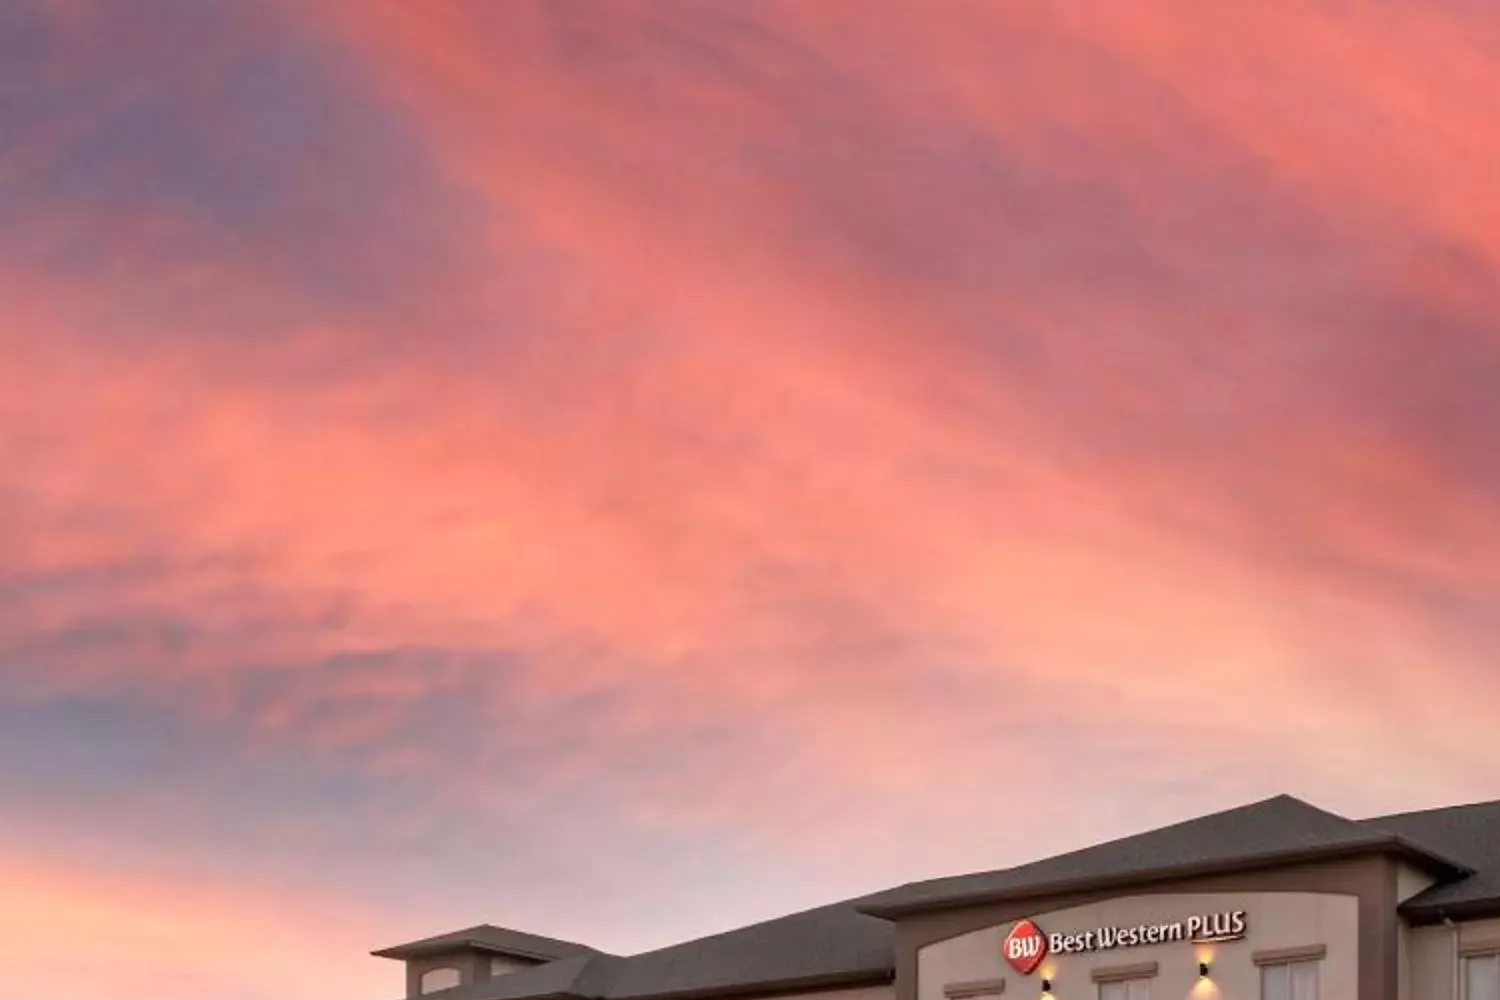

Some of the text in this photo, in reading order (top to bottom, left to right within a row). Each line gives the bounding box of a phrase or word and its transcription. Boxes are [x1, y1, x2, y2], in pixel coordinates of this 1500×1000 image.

[1008, 936, 1040, 959] BW
[1049, 911, 1245, 953] Best Western PLUS
